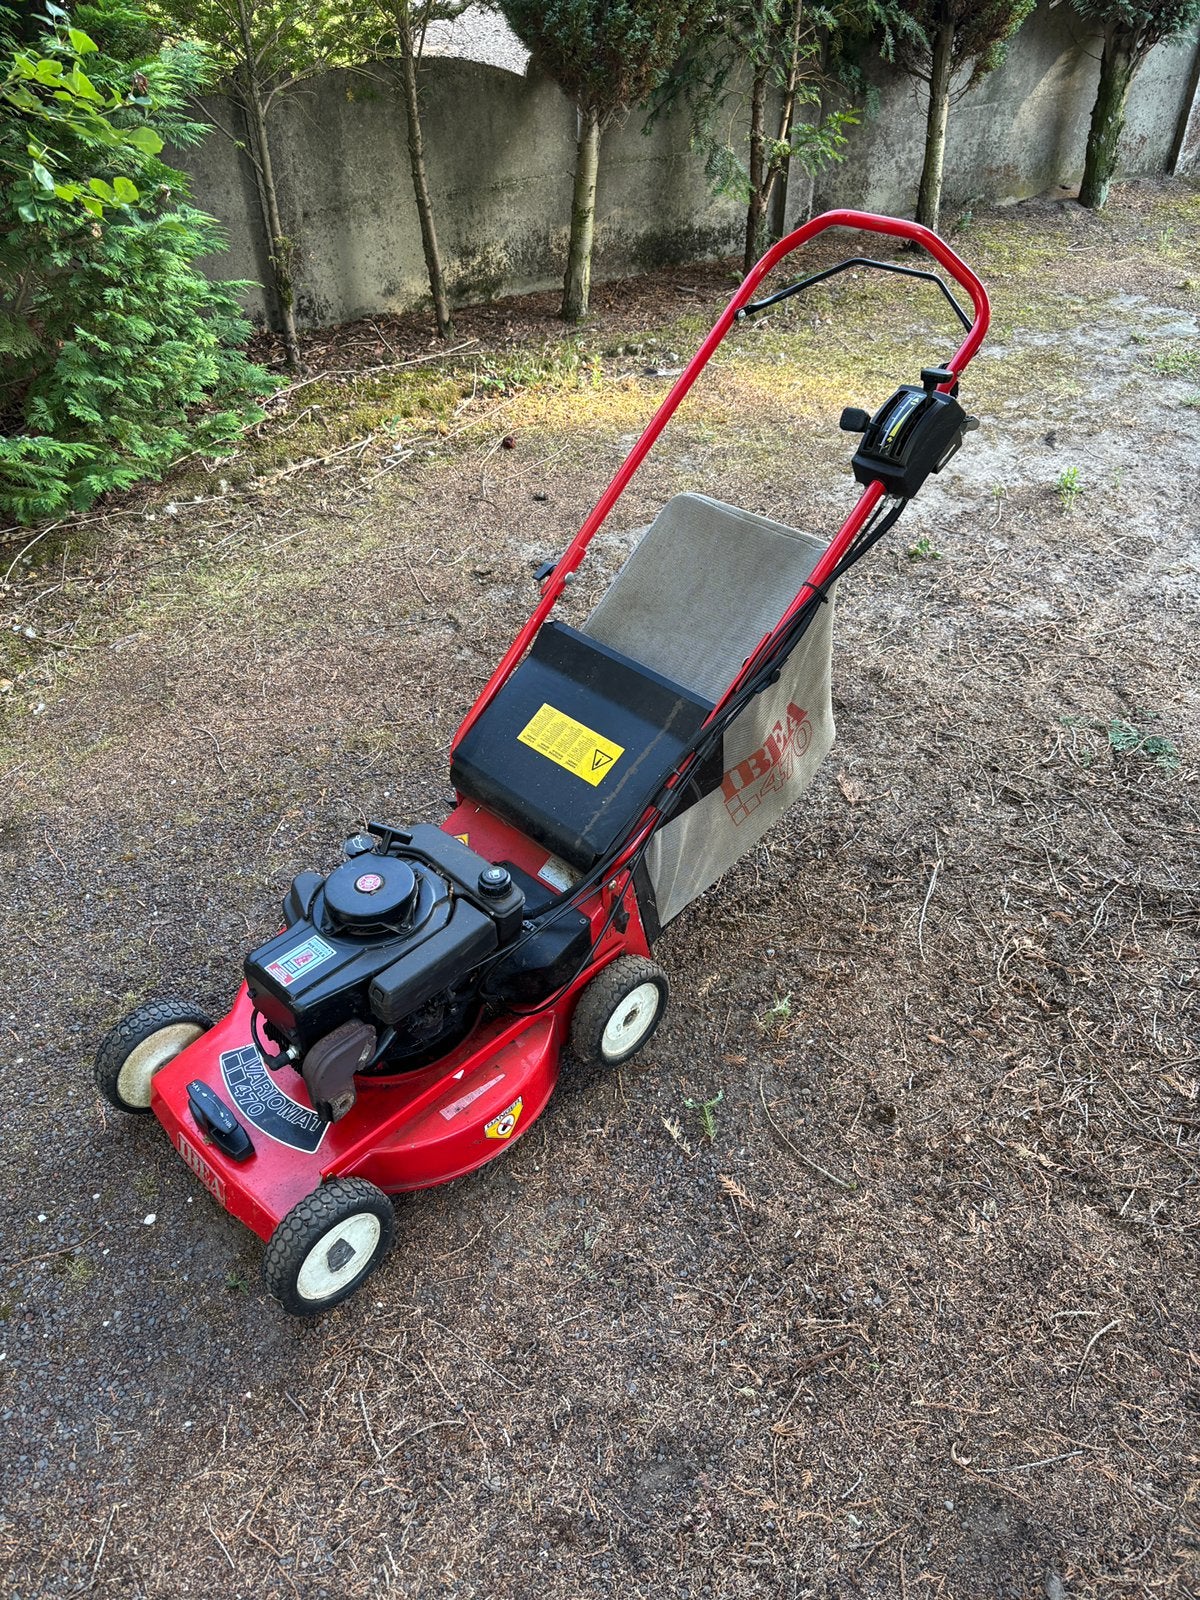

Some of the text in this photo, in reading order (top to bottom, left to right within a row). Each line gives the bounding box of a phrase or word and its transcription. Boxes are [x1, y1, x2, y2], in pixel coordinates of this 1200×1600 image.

[720, 702, 808, 803] IBEA
[760, 720, 813, 798] 470
[233, 1084, 266, 1117] 470
[243, 1059, 321, 1132] VARIOMAT
[486, 1098, 521, 1129] DANGER
[179, 1138, 224, 1200] IBEA
